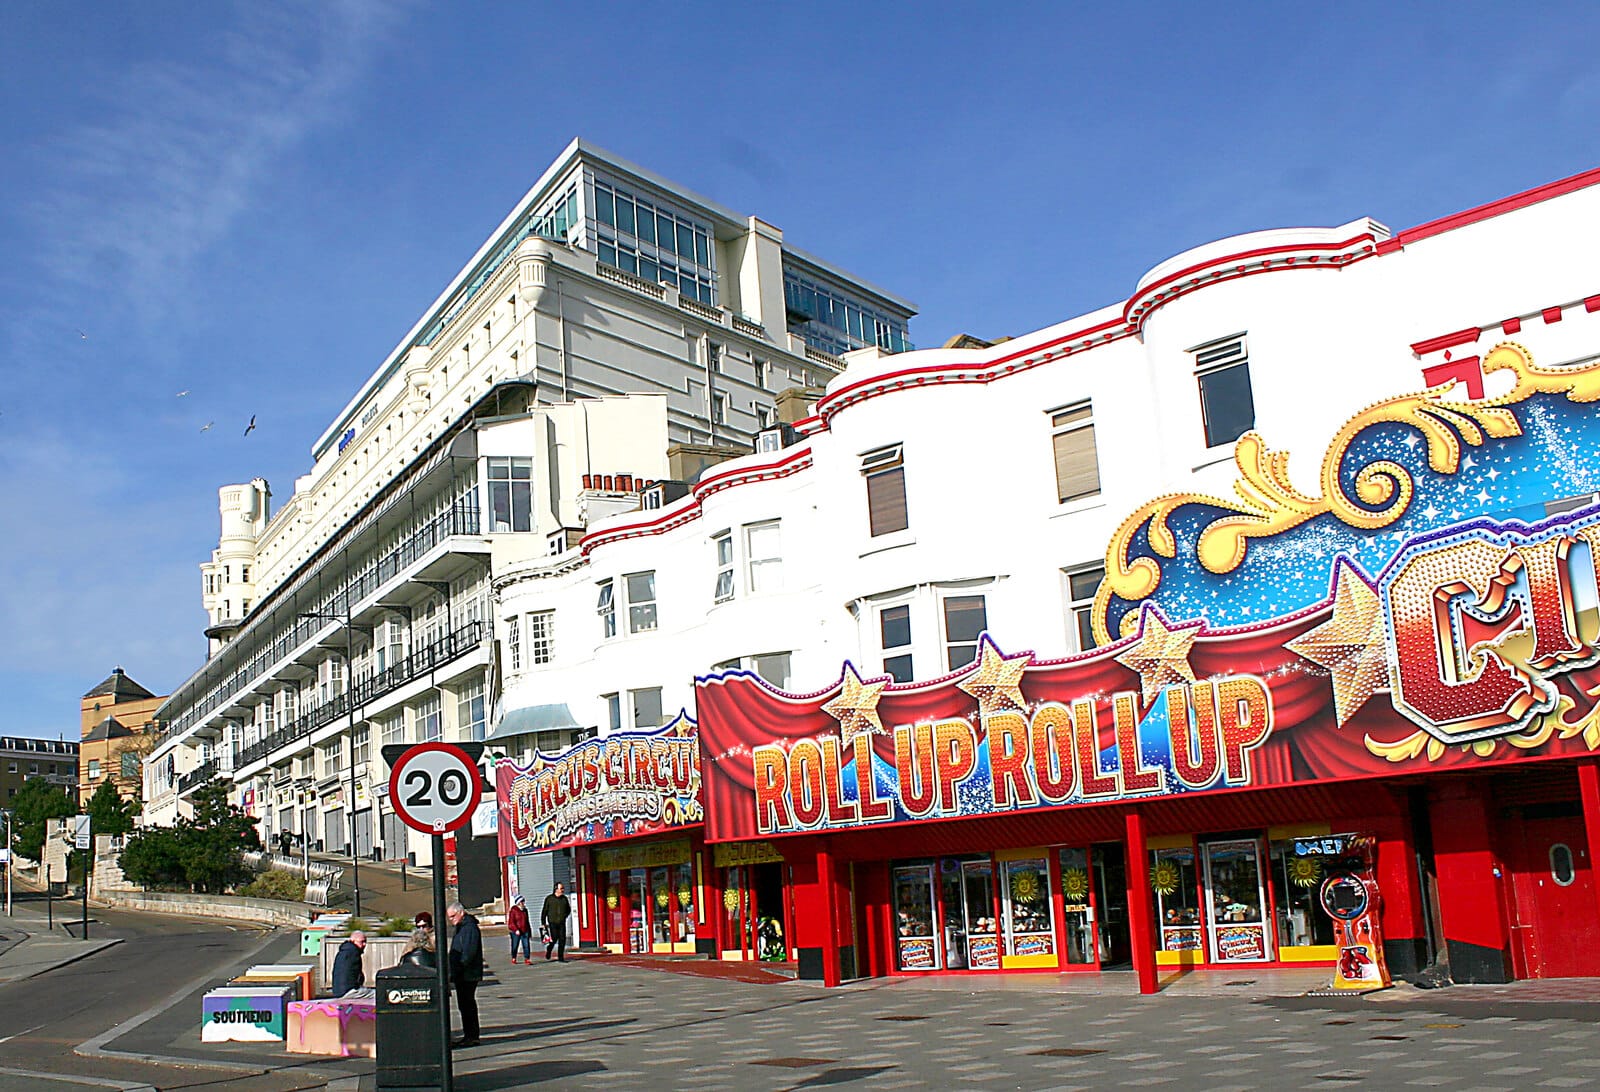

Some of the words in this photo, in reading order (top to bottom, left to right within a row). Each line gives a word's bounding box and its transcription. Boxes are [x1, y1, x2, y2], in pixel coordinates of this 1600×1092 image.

[752, 731, 893, 834] ROLL
[894, 717, 977, 816] UP
[985, 691, 1162, 807] ROLL
[1167, 675, 1273, 787] UP
[404, 769, 468, 806] 20
[511, 743, 600, 847] CIRCUS
[556, 791, 661, 832] AMUSEMENTS
[213, 1010, 272, 1023] SOUTHEND
